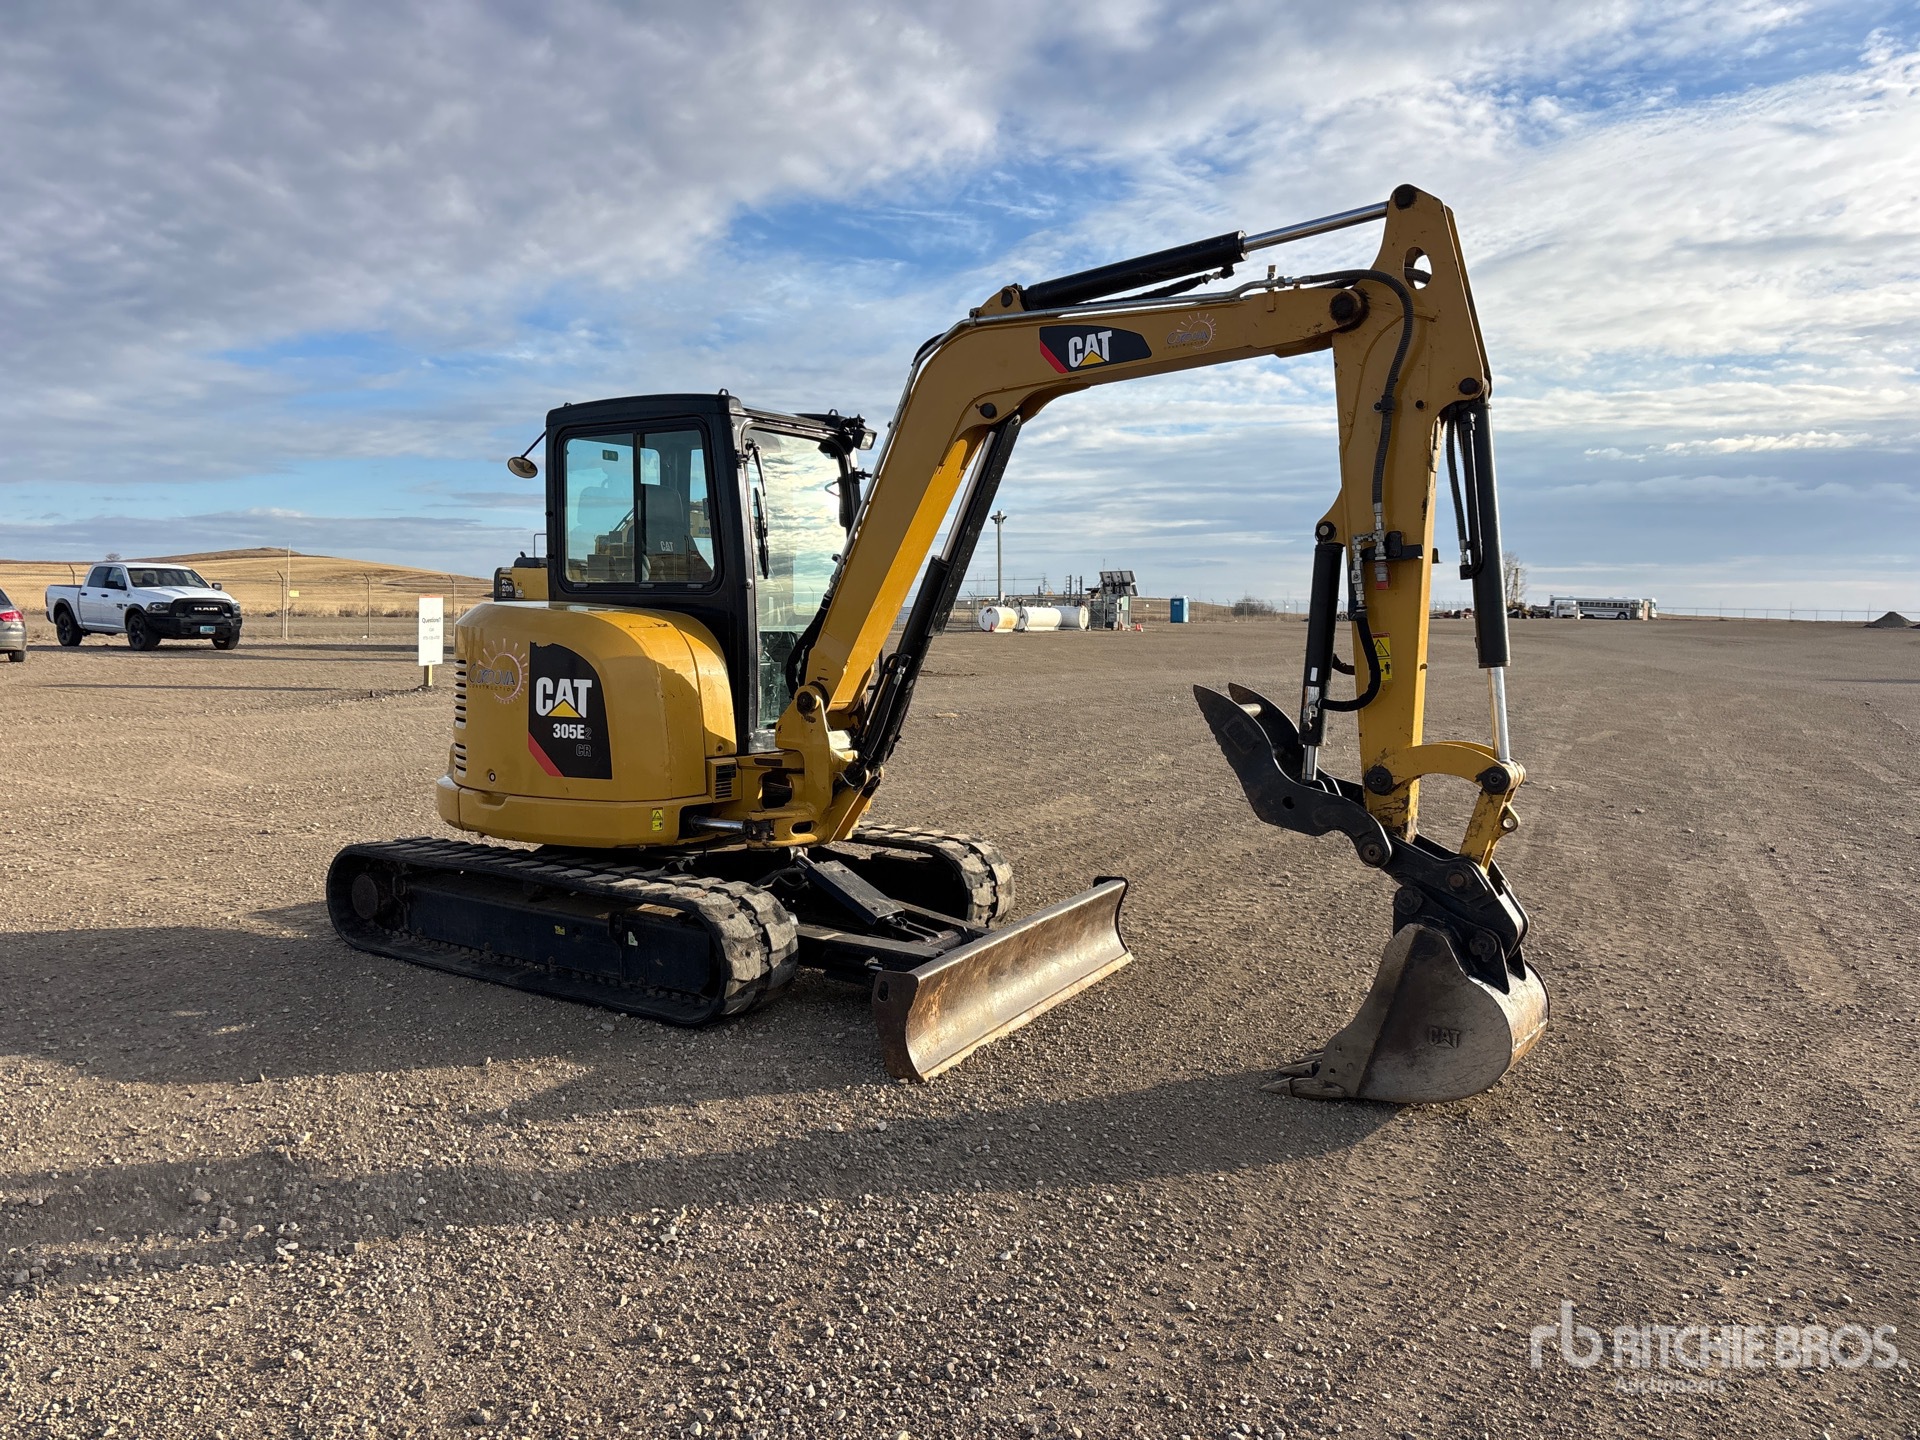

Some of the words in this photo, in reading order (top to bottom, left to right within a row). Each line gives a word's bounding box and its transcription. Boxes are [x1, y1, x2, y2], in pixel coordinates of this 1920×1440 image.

[1068, 330, 1113, 368] CAT
[660, 541, 674, 552] CAT
[501, 585, 514, 593] 200
[536, 676, 593, 719] CAT
[576, 743, 593, 758] CR
[1427, 1025, 1461, 1049] CAT
